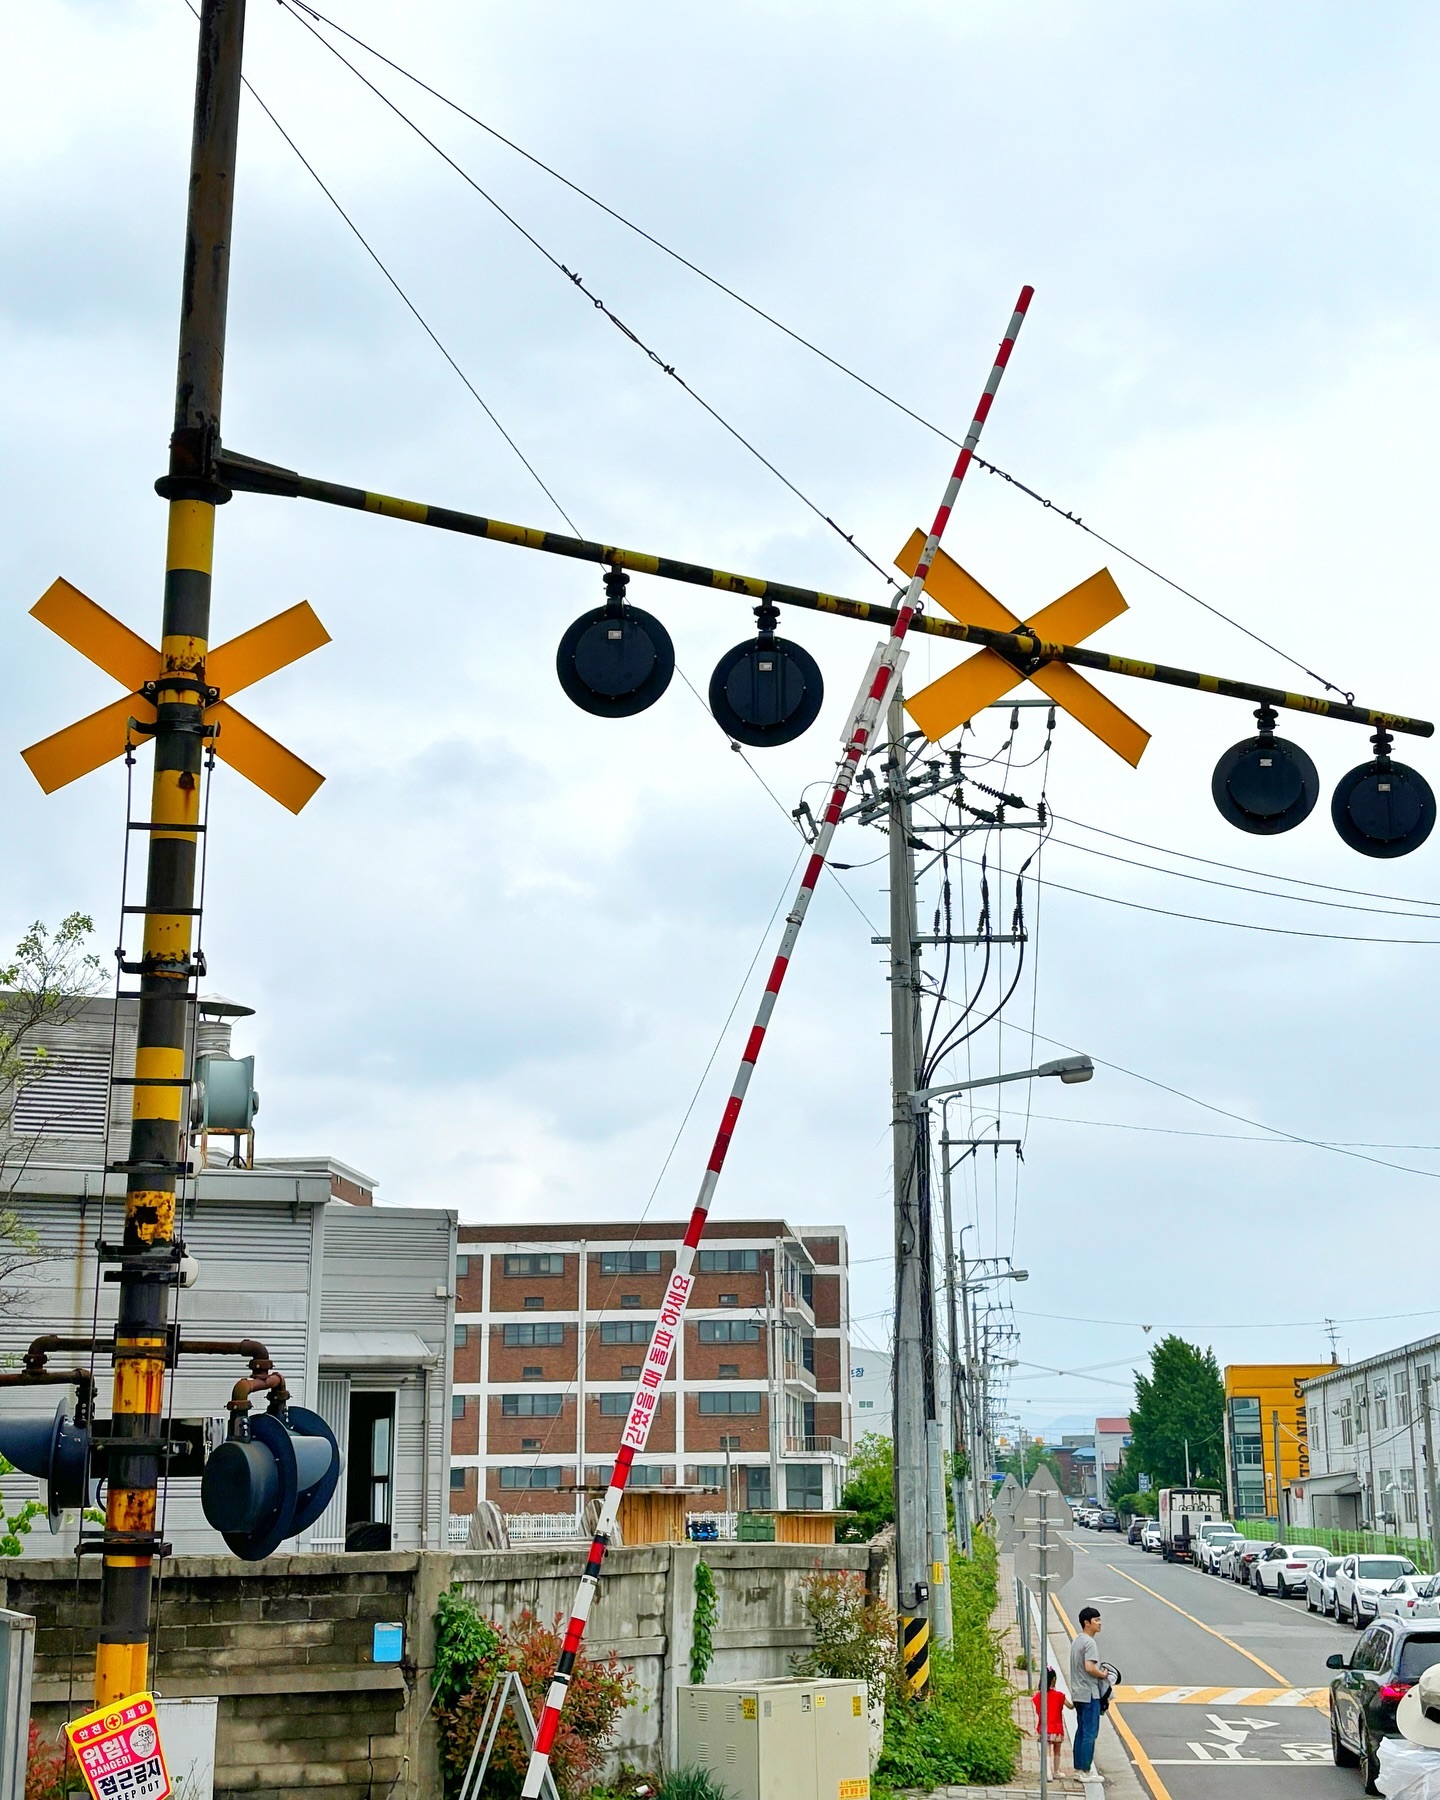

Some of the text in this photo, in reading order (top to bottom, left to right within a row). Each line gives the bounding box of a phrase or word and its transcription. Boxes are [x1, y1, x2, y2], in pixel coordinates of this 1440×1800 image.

[626, 1274, 691, 1445] 갇혔을 때 돌파 하세요
[1295, 1406, 1308, 1437] WIN
[82, 1735, 130, 1768] 위험!
[90, 1754, 133, 1778] DANGER!
[98, 1758, 162, 1796] 접근금지
[141, 1781, 160, 1795] OUT
